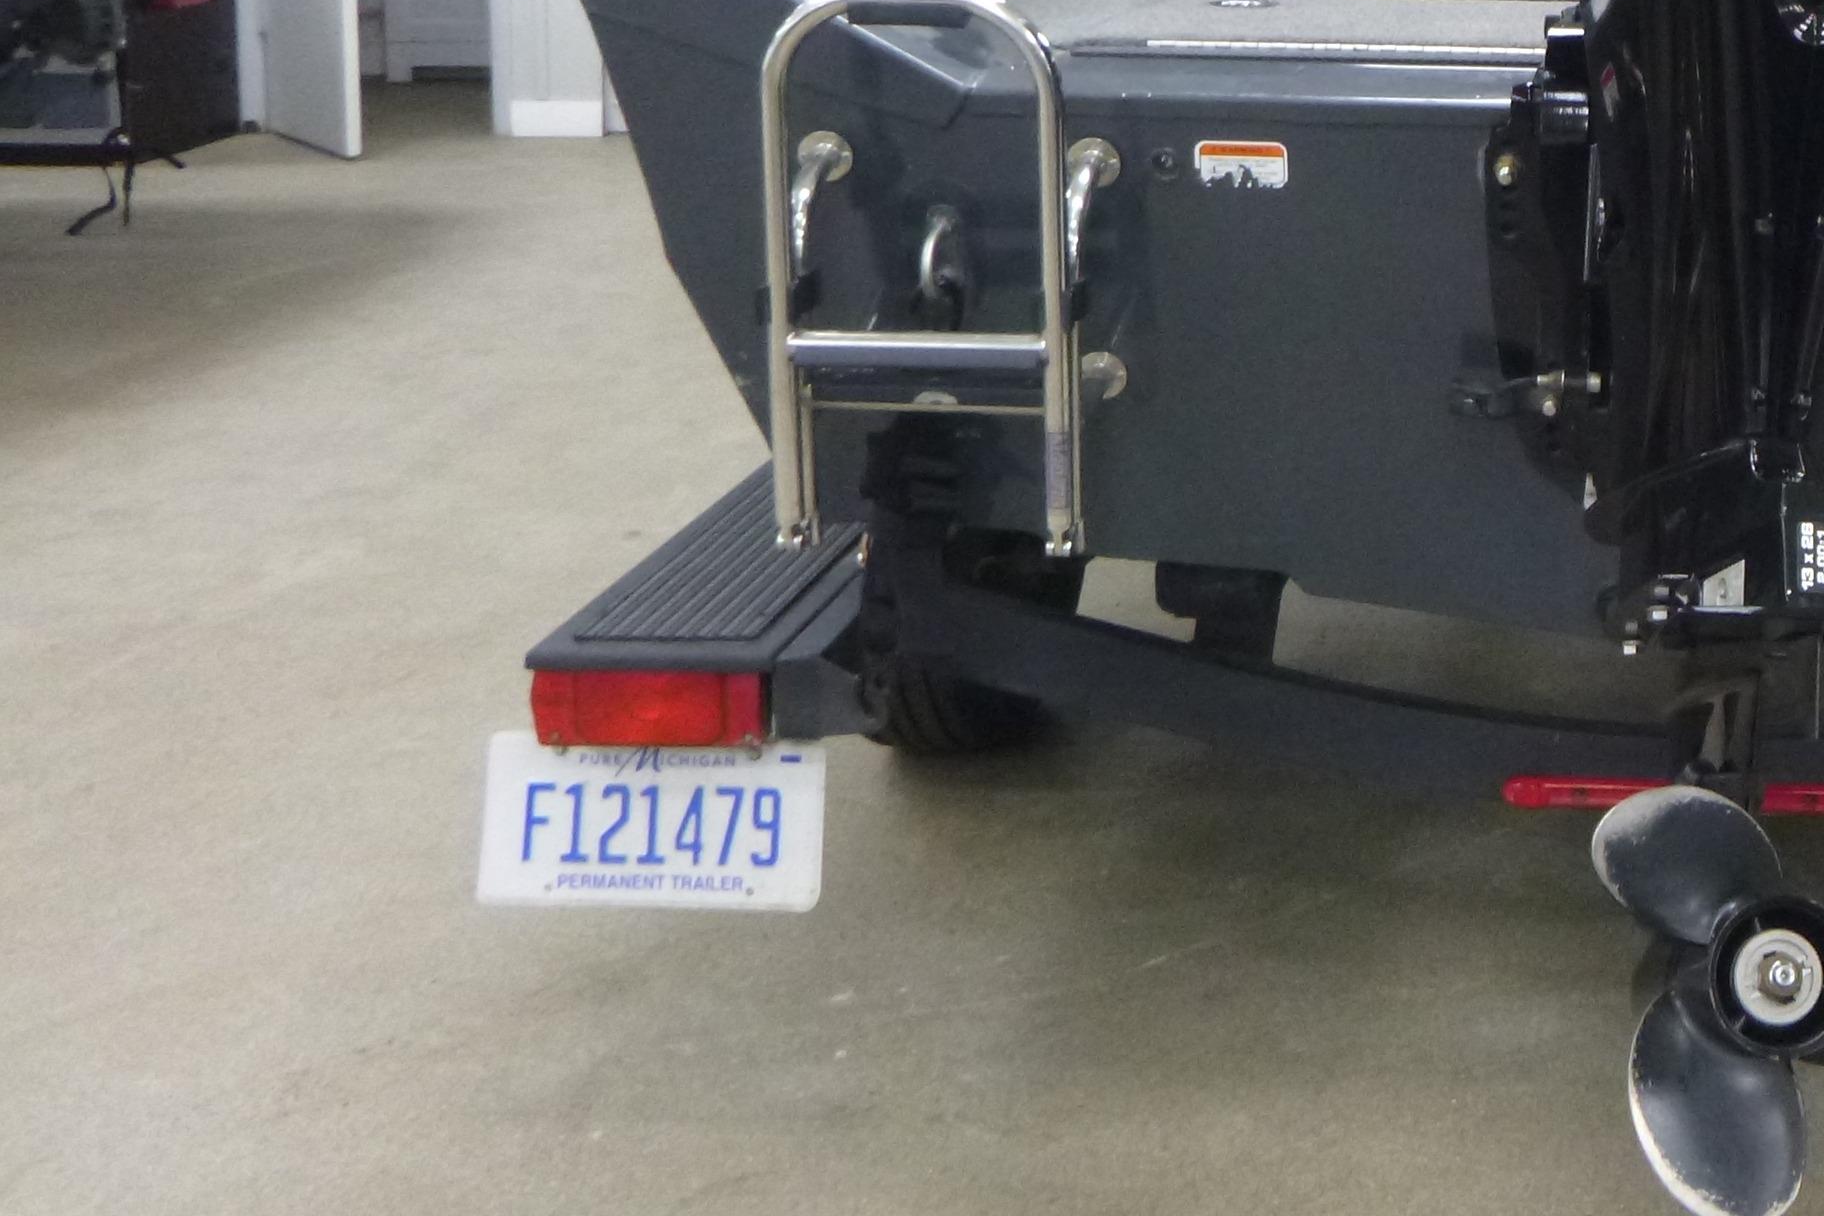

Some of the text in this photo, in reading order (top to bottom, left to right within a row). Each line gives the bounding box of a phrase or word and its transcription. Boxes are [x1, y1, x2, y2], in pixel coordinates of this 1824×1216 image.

[1801, 567, 1814, 591] 13
[579, 752, 624, 765] PURE
[521, 781, 782, 867] F121479
[557, 873, 744, 890] PERMANENT TRAILER
